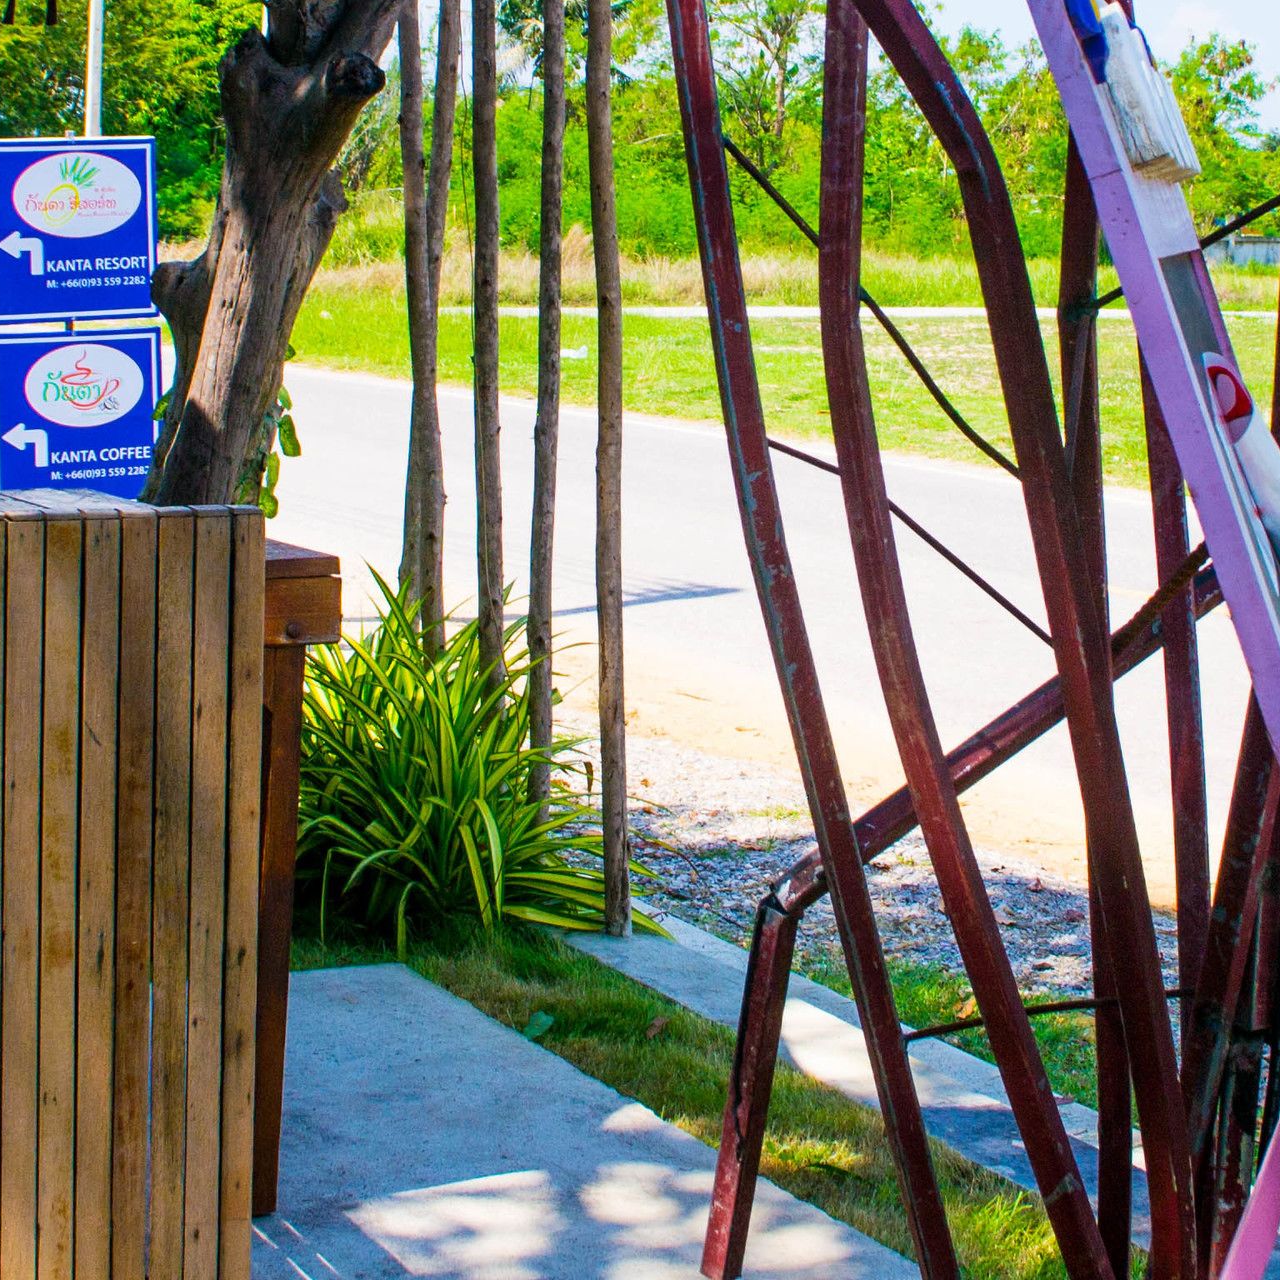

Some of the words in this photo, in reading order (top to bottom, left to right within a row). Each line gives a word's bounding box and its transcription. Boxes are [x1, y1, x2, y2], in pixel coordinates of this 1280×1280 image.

[46, 258, 92, 272] KANTA
[95, 256, 147, 270] RESORT
[46, 279, 59, 288] M:
[61, 277, 102, 288] +66(0)93
[104, 276, 121, 286] 559
[123, 275, 146, 285] 2282
[51, 450, 97, 464] KANTA
[100, 446, 151, 461] COFFEE
[65, 469, 106, 479] +66(0)93
[108, 467, 125, 477] 559
